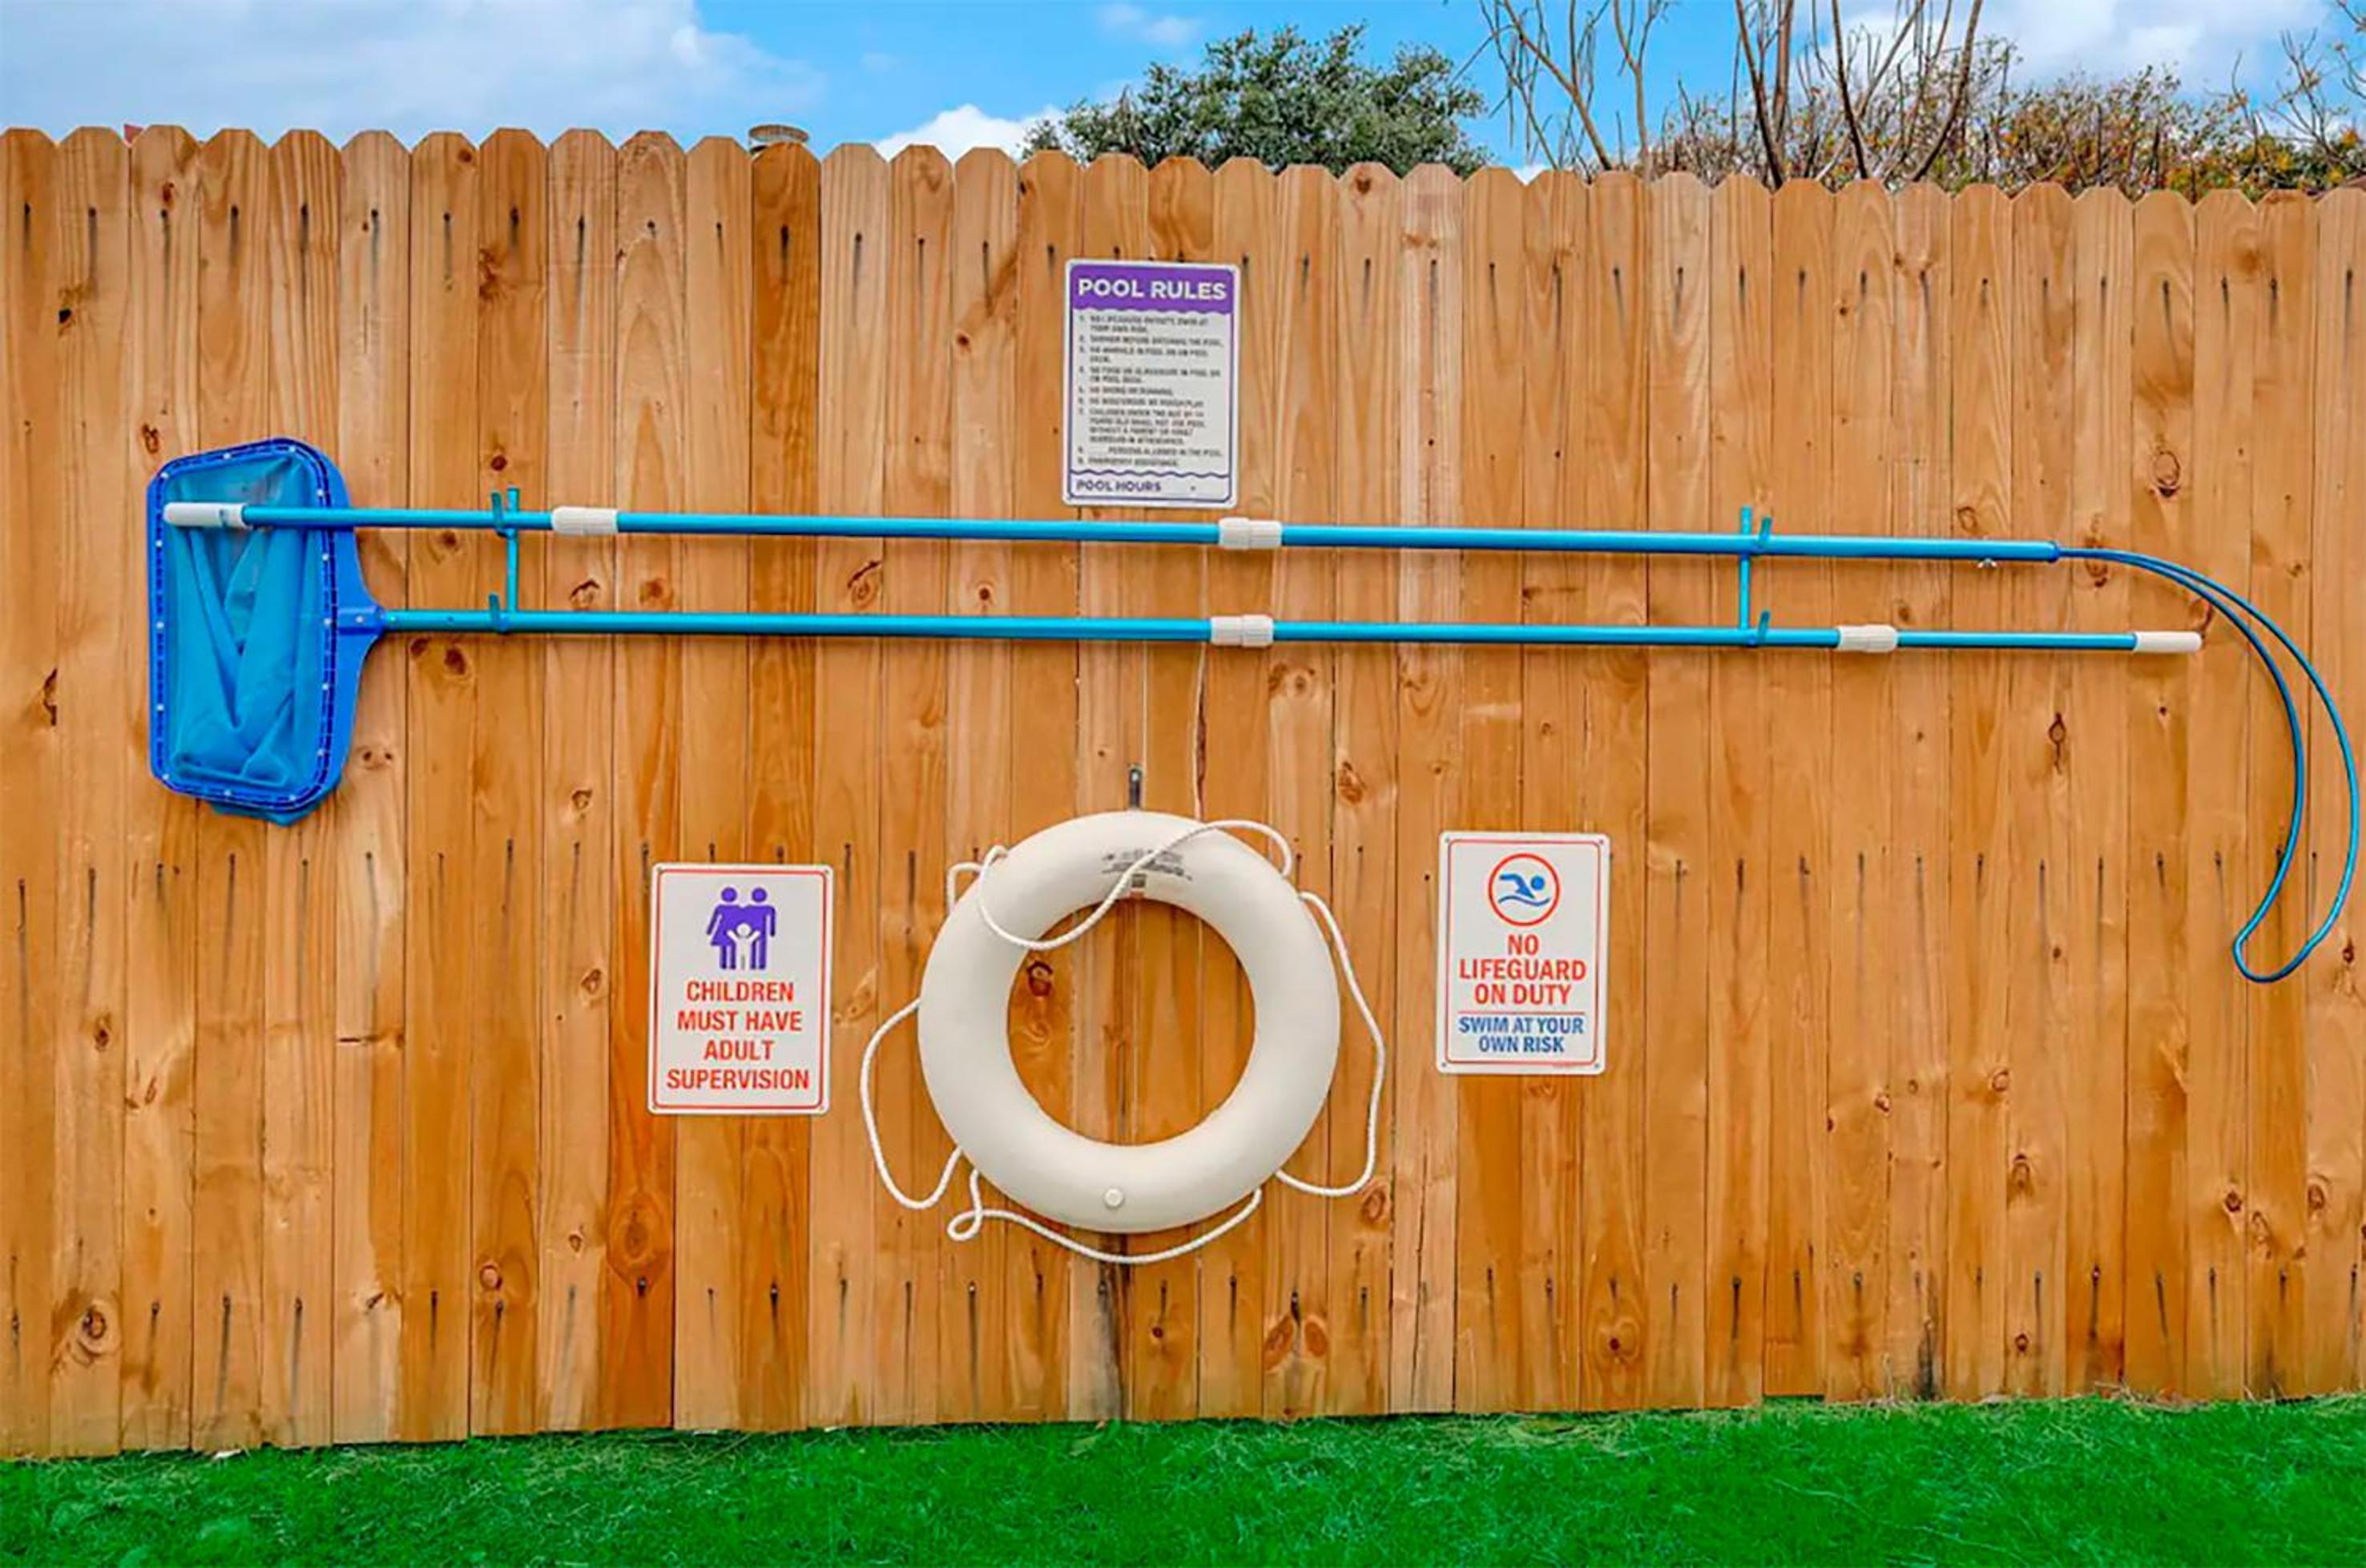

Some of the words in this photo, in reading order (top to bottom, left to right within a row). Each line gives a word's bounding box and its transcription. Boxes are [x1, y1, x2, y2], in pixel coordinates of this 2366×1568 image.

[1078, 278, 1144, 298] POOL
[1151, 280, 1226, 300] RULES
[1077, 480, 1113, 491] POOL
[1115, 481, 1161, 492] HOURS
[1508, 934, 1539, 955] NO
[1460, 959, 1586, 981] LIFEGUARD
[687, 982, 794, 1002] CHILDREN
[1475, 984, 1509, 1005] ON
[1513, 984, 1572, 1005] DUTY
[677, 1010, 738, 1031] MUST
[745, 1011, 803, 1031] HAVE
[1458, 1017, 1509, 1034] SWIM
[1513, 1018, 1533, 1033] AT
[1538, 1018, 1584, 1034] YOUR
[704, 1040, 774, 1060] ADULT
[1479, 1036, 1519, 1052] OWN
[1523, 1037, 1565, 1053] RISK
[667, 1069, 809, 1090] SUPERVISION
